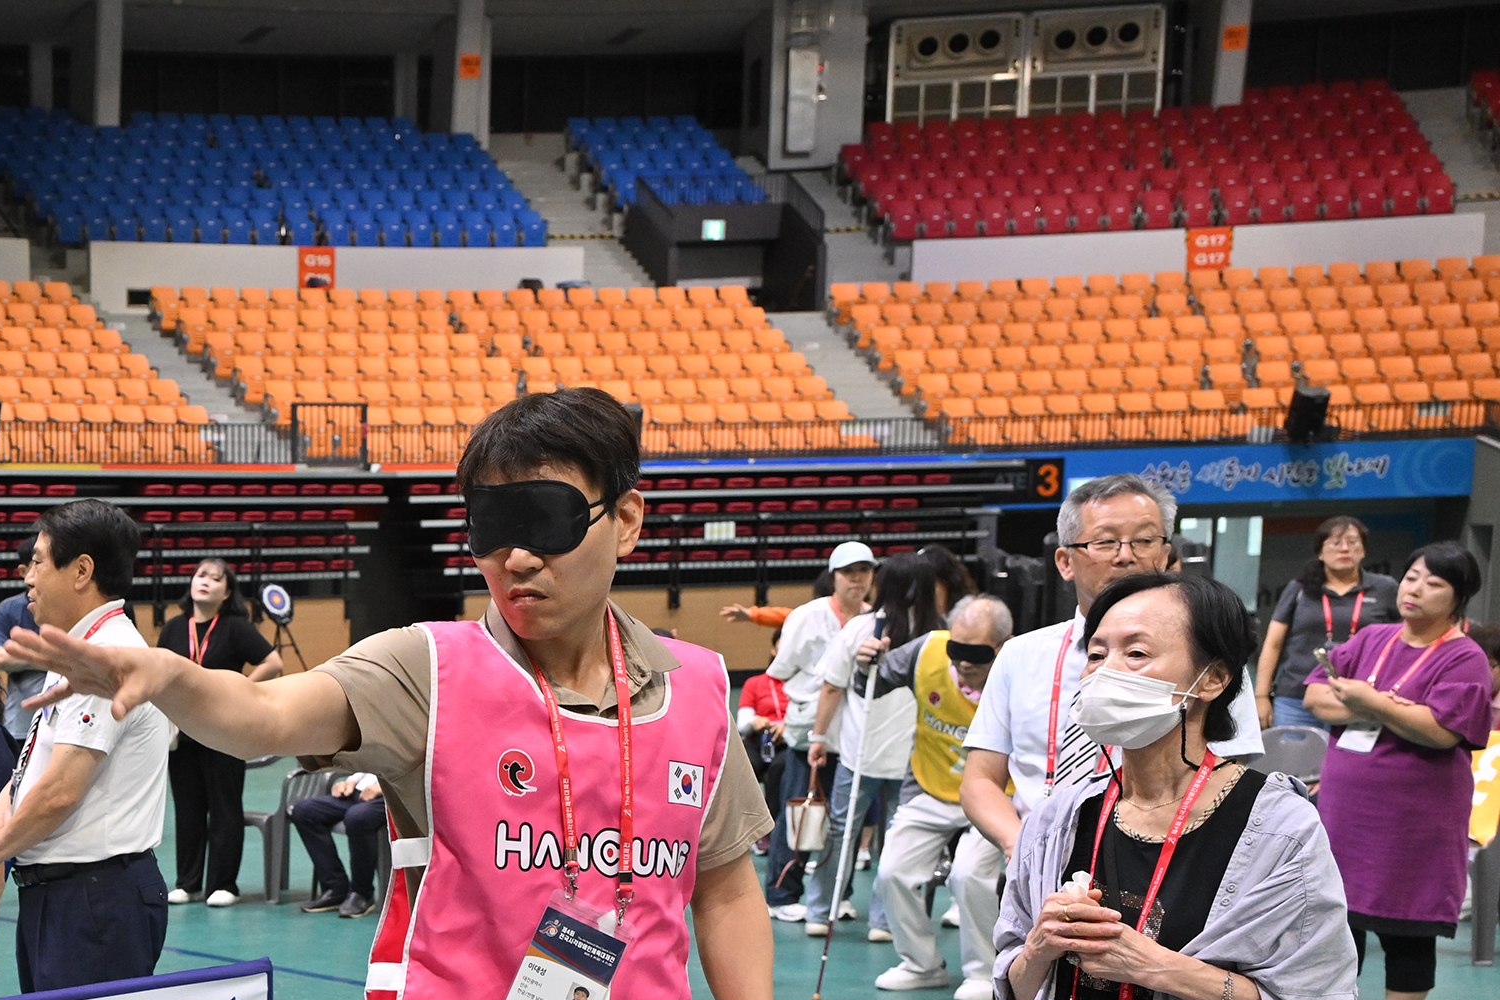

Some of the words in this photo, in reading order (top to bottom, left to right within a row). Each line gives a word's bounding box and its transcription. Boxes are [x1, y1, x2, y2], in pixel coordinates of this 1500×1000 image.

[1196, 235, 1227, 247] G17
[1195, 253, 1225, 265] G17
[1036, 463, 1060, 497] 3
[547, 699, 560, 721] National
[552, 721, 560, 731] 4th
[554, 731, 562, 742] The
[1170, 819, 1181, 835] 제4회
[1177, 764, 1209, 821] 전국시각장애인체육대제전
[495, 820, 691, 878] HANGUNG
[1147, 884, 1156, 902] Sports
[1153, 866, 1163, 885] Games
[561, 926, 576, 936] 제4회
[528, 963, 547, 976] 이대성
